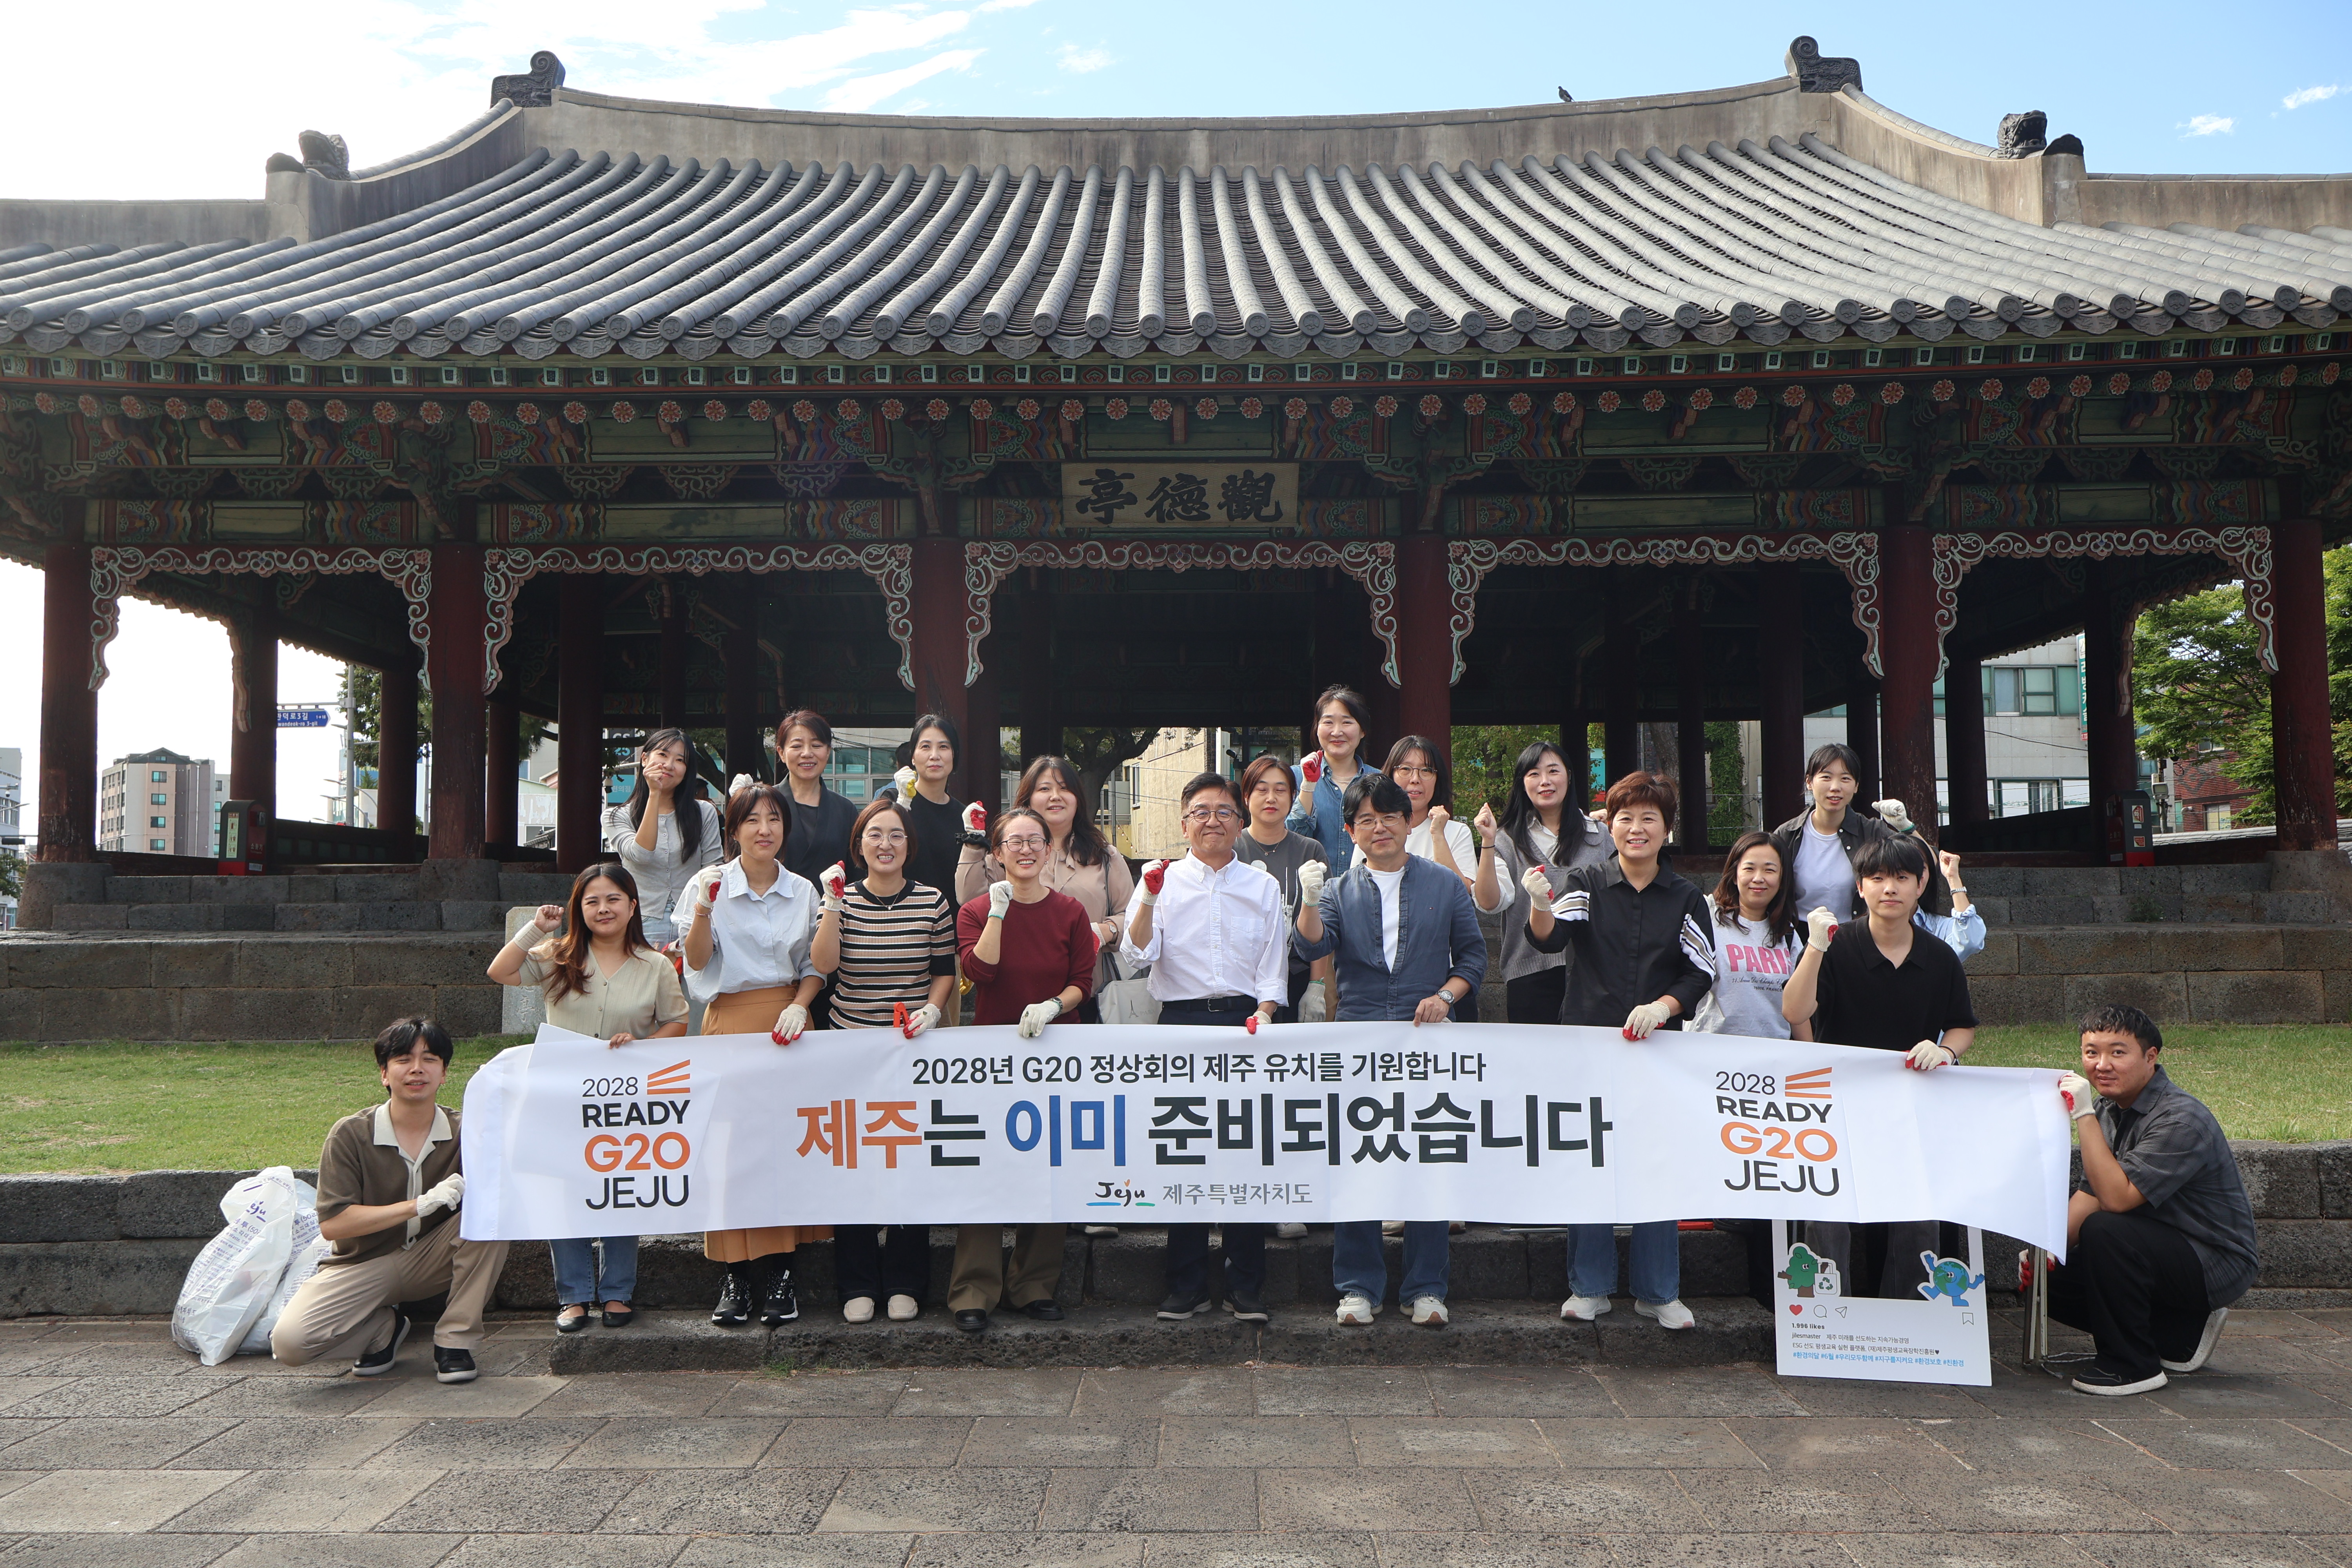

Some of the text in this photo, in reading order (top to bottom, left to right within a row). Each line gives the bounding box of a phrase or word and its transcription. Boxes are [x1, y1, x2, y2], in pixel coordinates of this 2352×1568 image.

[913, 1051, 1486, 1085] 2028년 G20 정상회의 제주 유치를 기원합니다
[583, 1076, 638, 1097] 2028
[1716, 1071, 1775, 1095] 2028
[582, 1100, 691, 1128] READY
[1716, 1095, 1833, 1123] READY
[796, 1092, 1613, 1169] 제주는 이미 준비되었습니다
[1720, 1122, 1838, 1162] G20
[584, 1132, 690, 1172] G20
[1724, 1160, 1840, 1196] JEJU
[586, 1175, 689, 1210] JEJU
[1095, 1179, 1313, 1207] Jeju 제주특별자치도
[250, 1201, 266, 1215] eju
[1835, 1354, 1874, 1362] #우리모두함께
